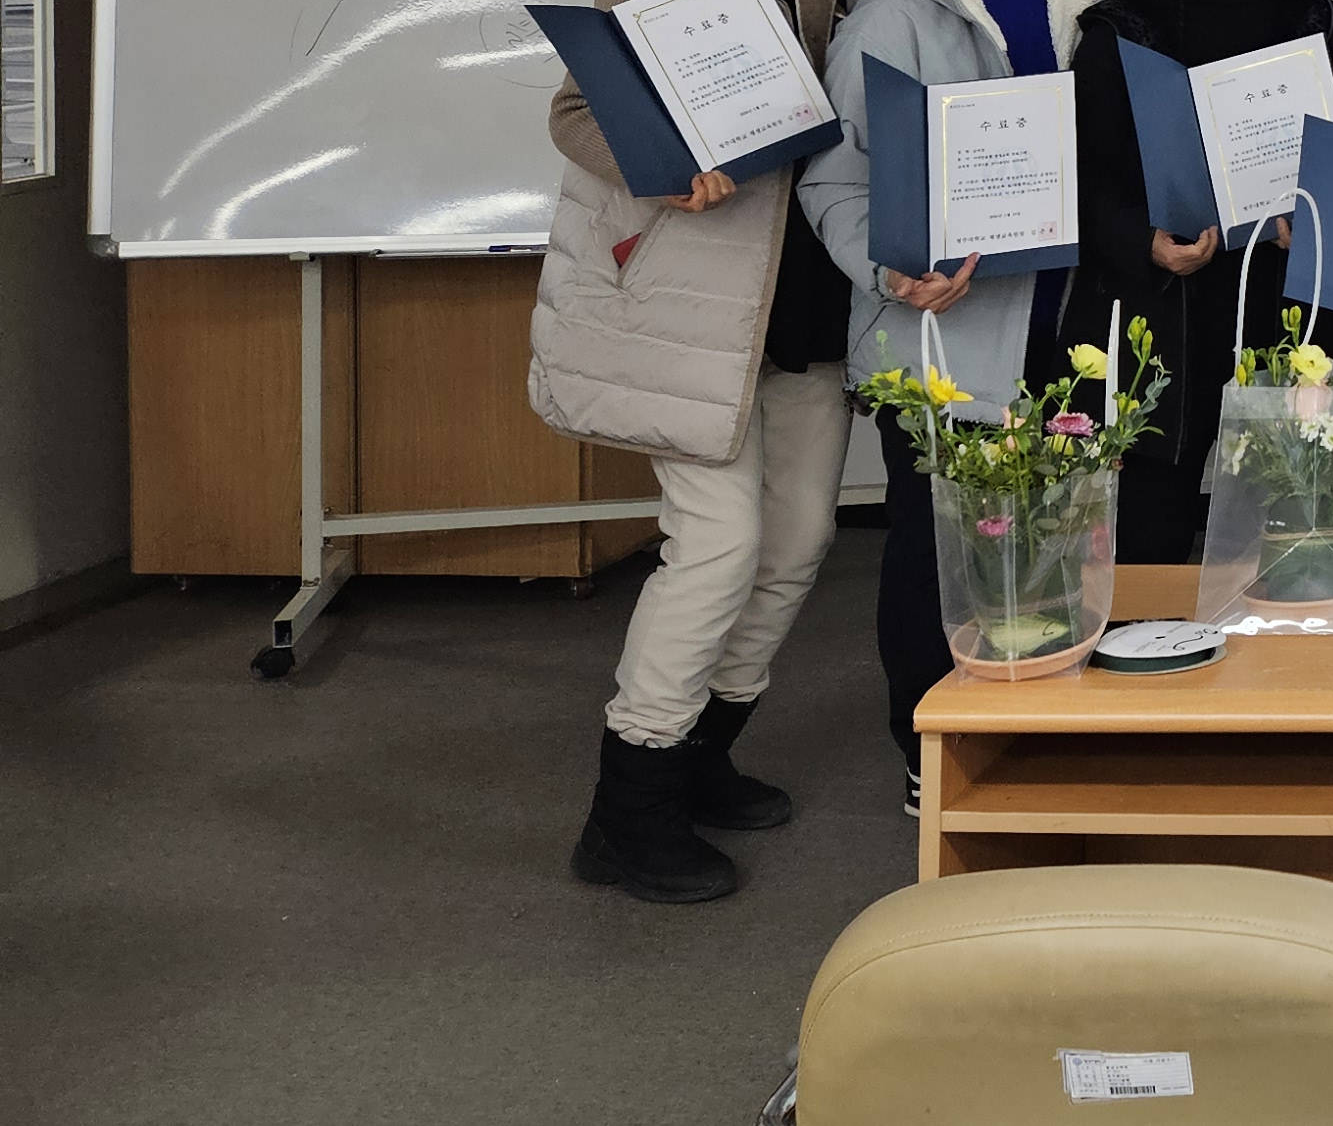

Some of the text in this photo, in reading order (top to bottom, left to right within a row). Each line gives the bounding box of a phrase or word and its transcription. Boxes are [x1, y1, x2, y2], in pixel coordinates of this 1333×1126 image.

[683, 13, 729, 37] 수료증
[1244, 84, 1288, 103] 수료증
[980, 117, 1027, 132] 수료증
